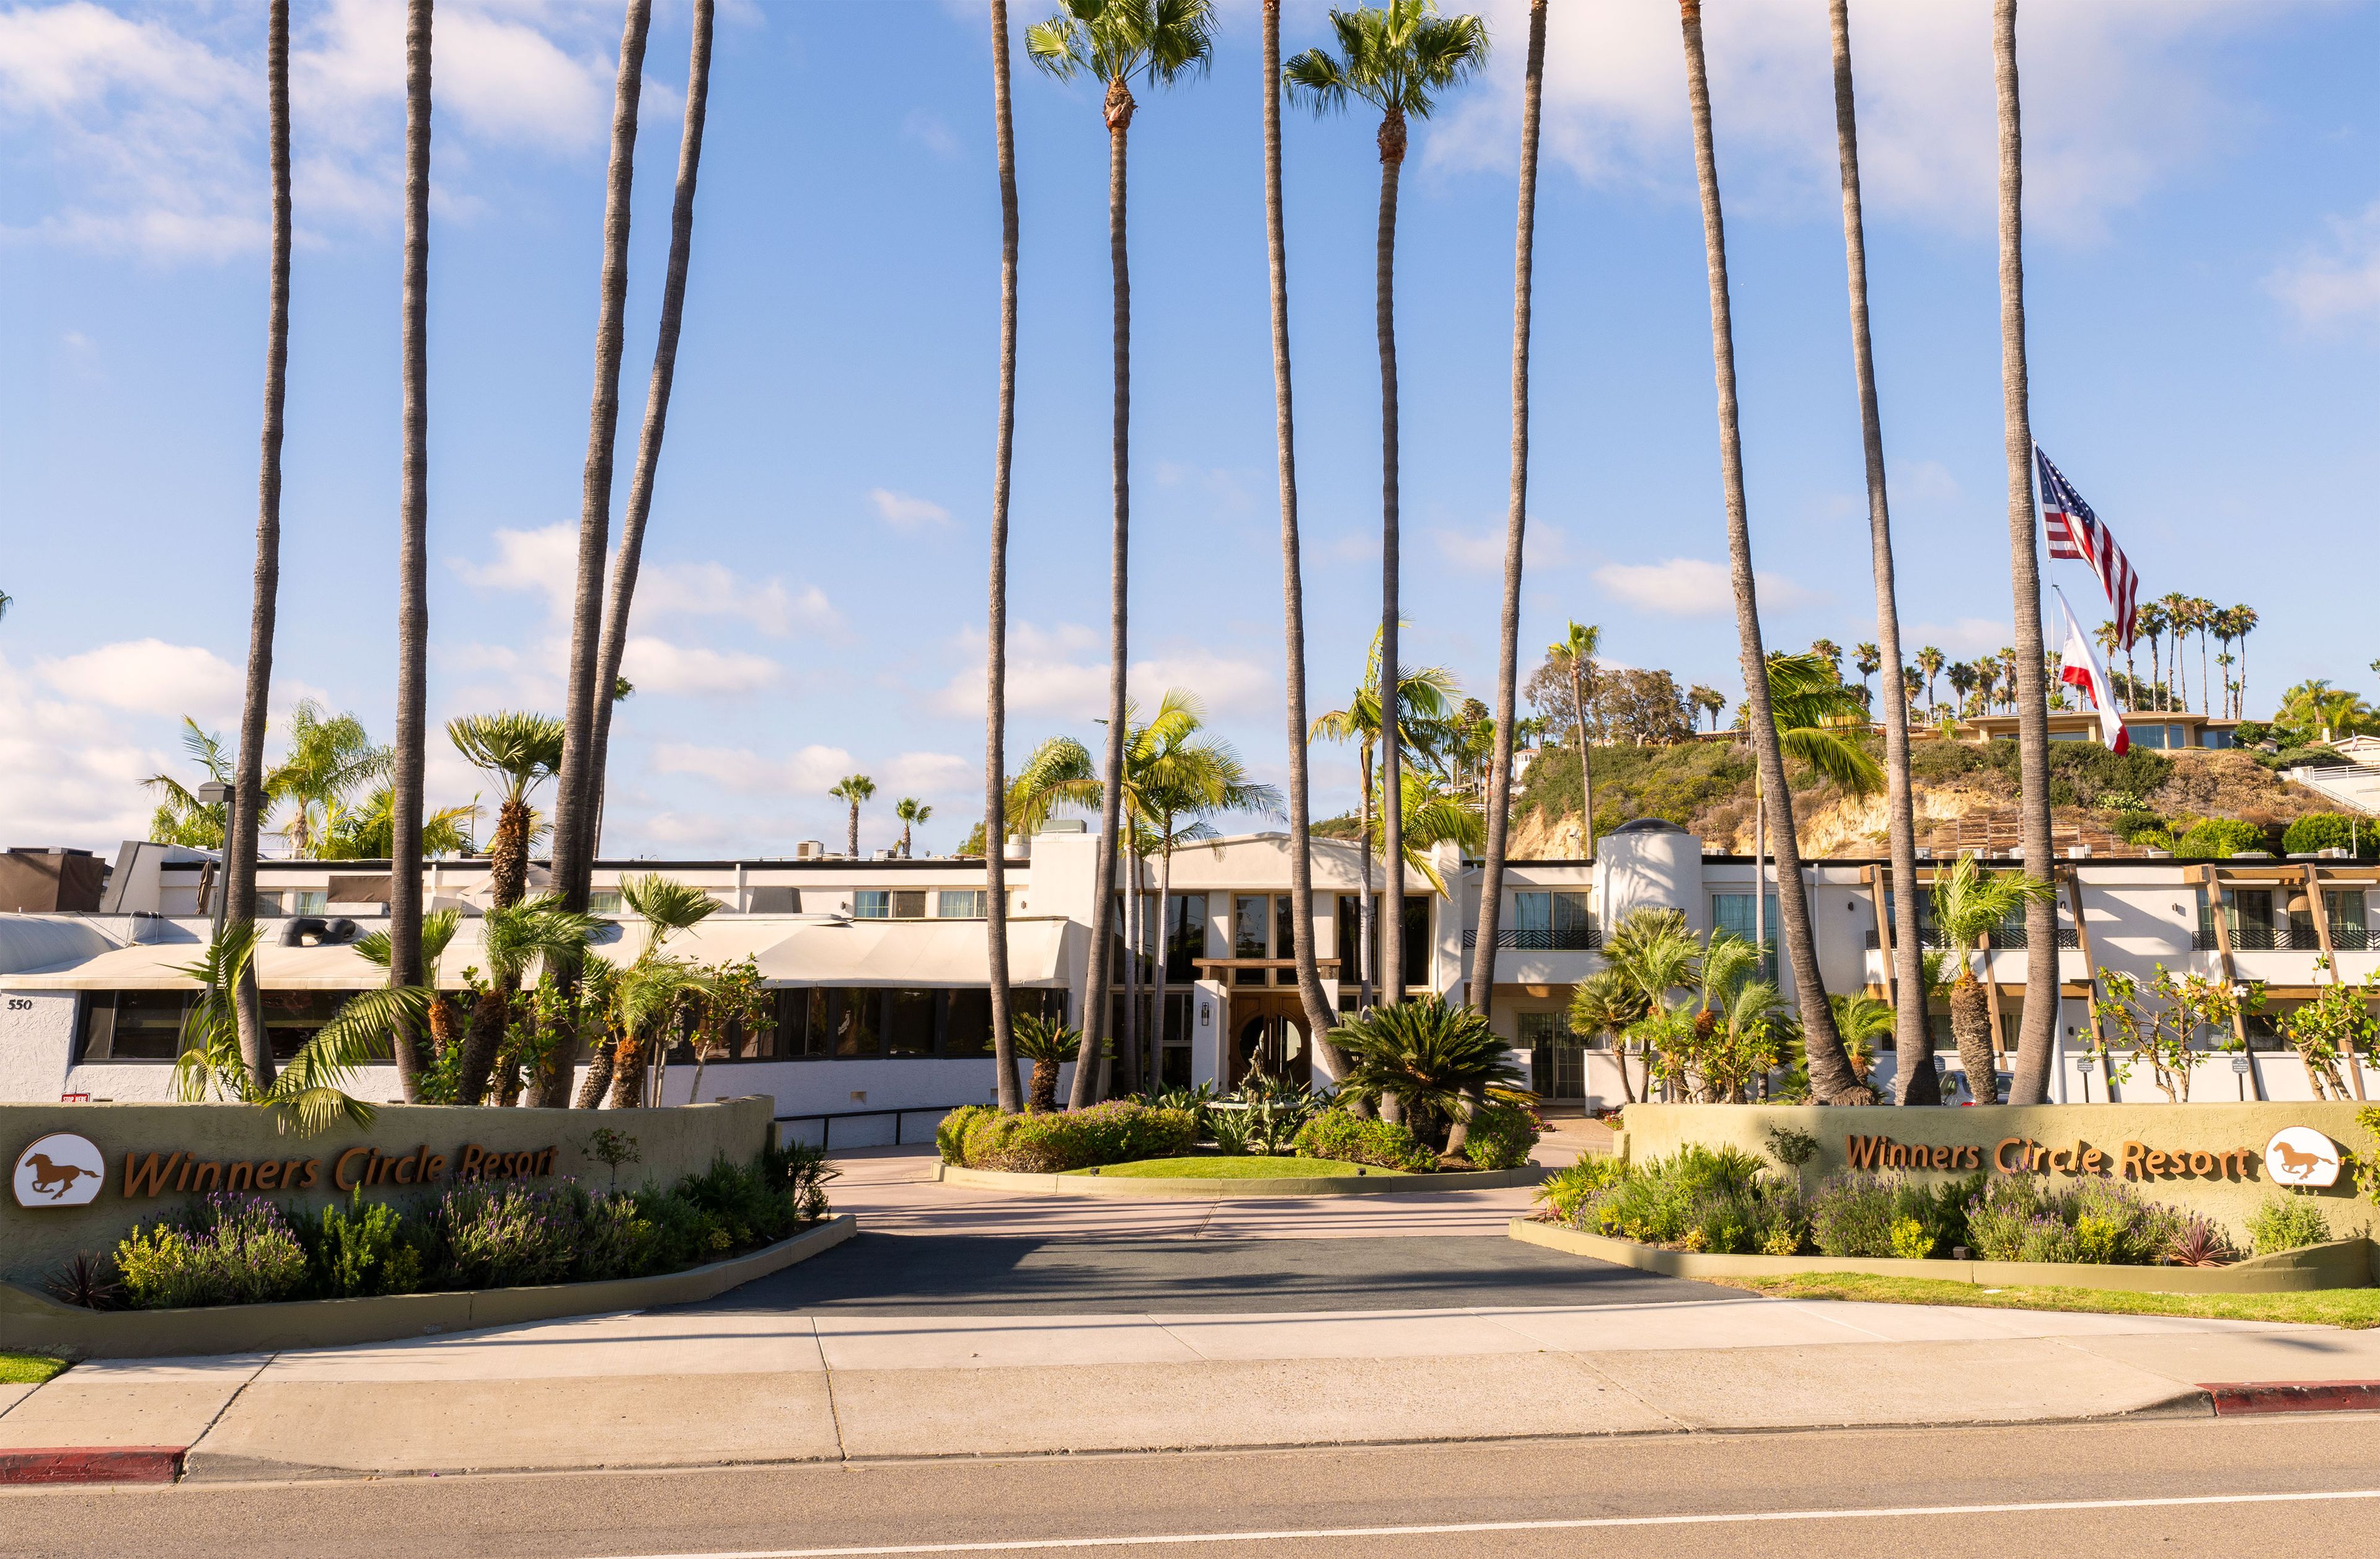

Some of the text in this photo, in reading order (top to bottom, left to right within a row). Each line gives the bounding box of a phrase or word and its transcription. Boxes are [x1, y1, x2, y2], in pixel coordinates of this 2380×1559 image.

[7, 999, 32, 1010] 550
[123, 1143, 559, 1198] Winners Circle Resort
[1845, 1135, 2249, 1177] Winners Circle Resort
